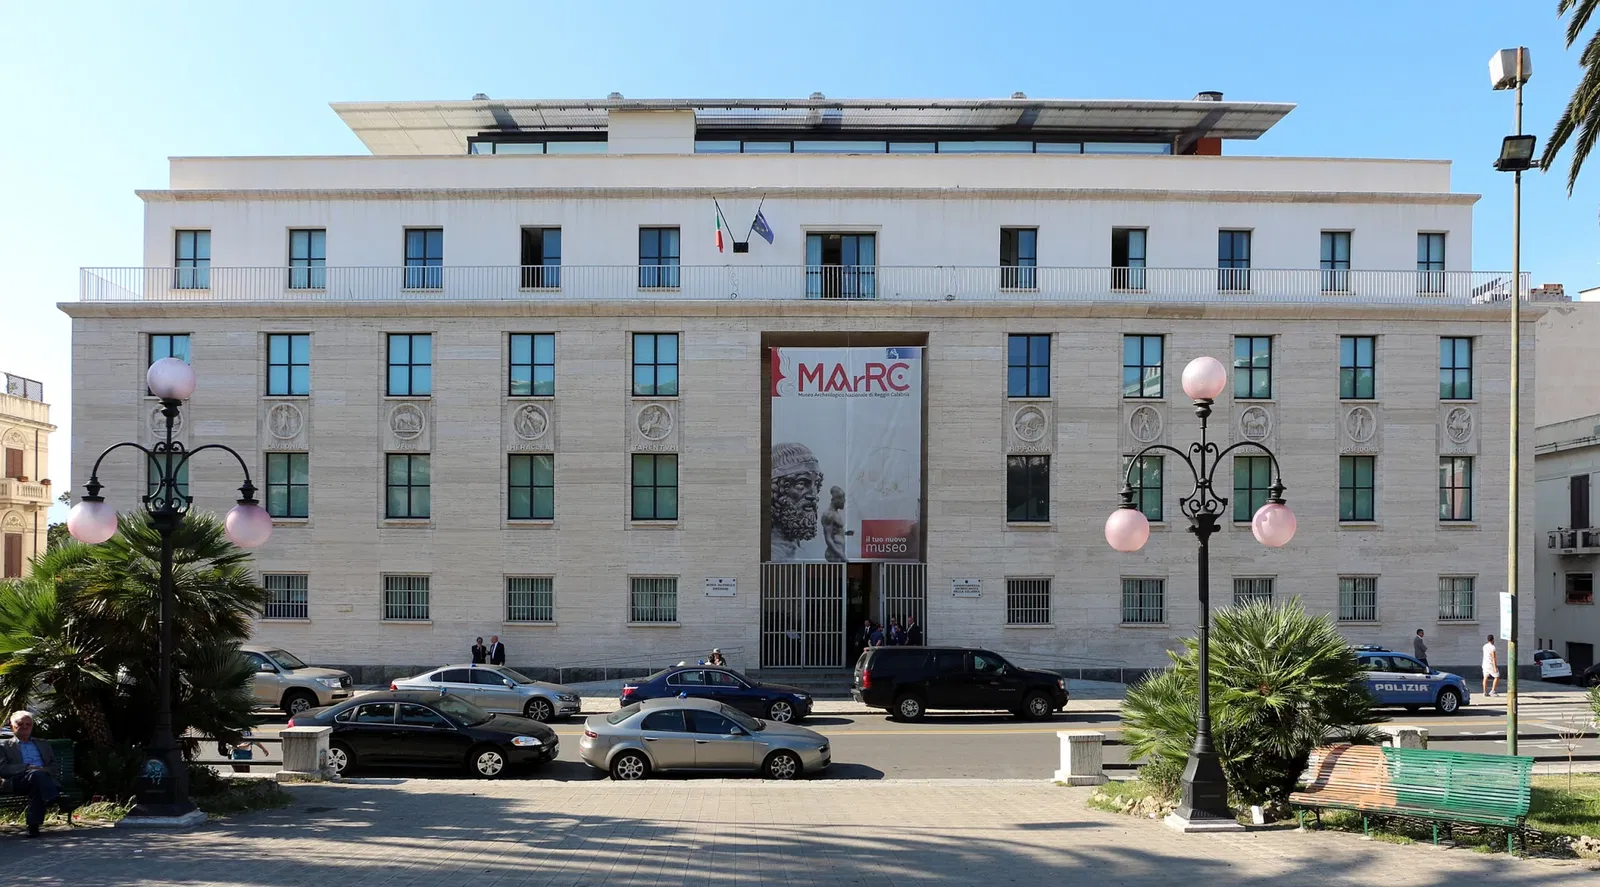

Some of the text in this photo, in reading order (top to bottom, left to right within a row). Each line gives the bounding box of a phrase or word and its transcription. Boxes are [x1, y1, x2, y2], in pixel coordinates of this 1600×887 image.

[798, 362, 910, 392] MArRC
[865, 535, 871, 543] il
[865, 543, 907, 553] museo
[1375, 683, 1429, 692] POLIZIA
